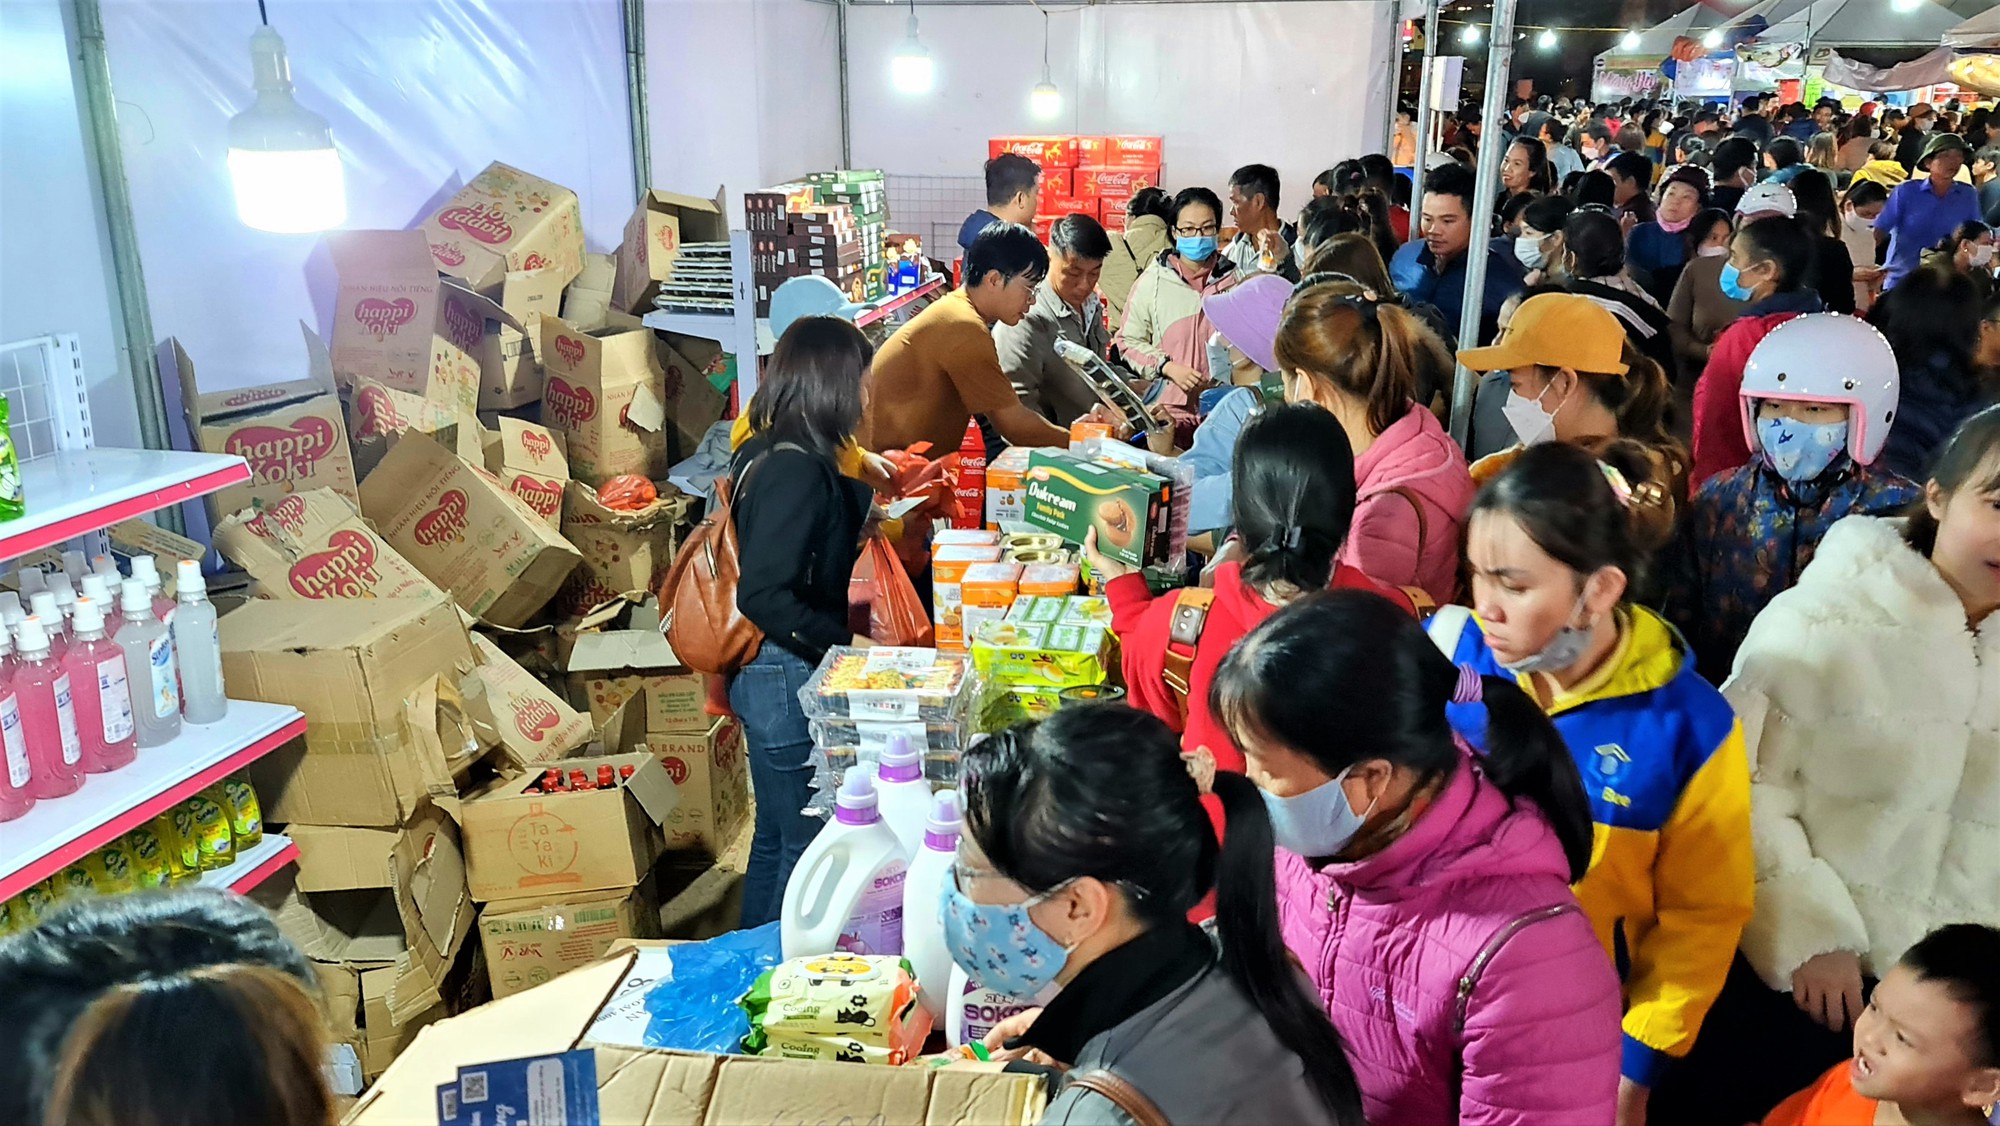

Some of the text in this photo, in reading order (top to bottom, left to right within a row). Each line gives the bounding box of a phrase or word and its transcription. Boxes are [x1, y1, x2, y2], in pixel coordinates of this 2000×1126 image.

[358, 303, 410, 322] happi
[548, 381, 591, 415] happi
[234, 424, 326, 462] happi
[523, 433, 549, 451] happi
[514, 482, 560, 510] happi
[1028, 481, 1077, 512] Dukream
[418, 494, 462, 544] happi
[431, 514, 471, 551] Koki
[294, 535, 369, 597] happi
[661, 744, 705, 754] BRAND
